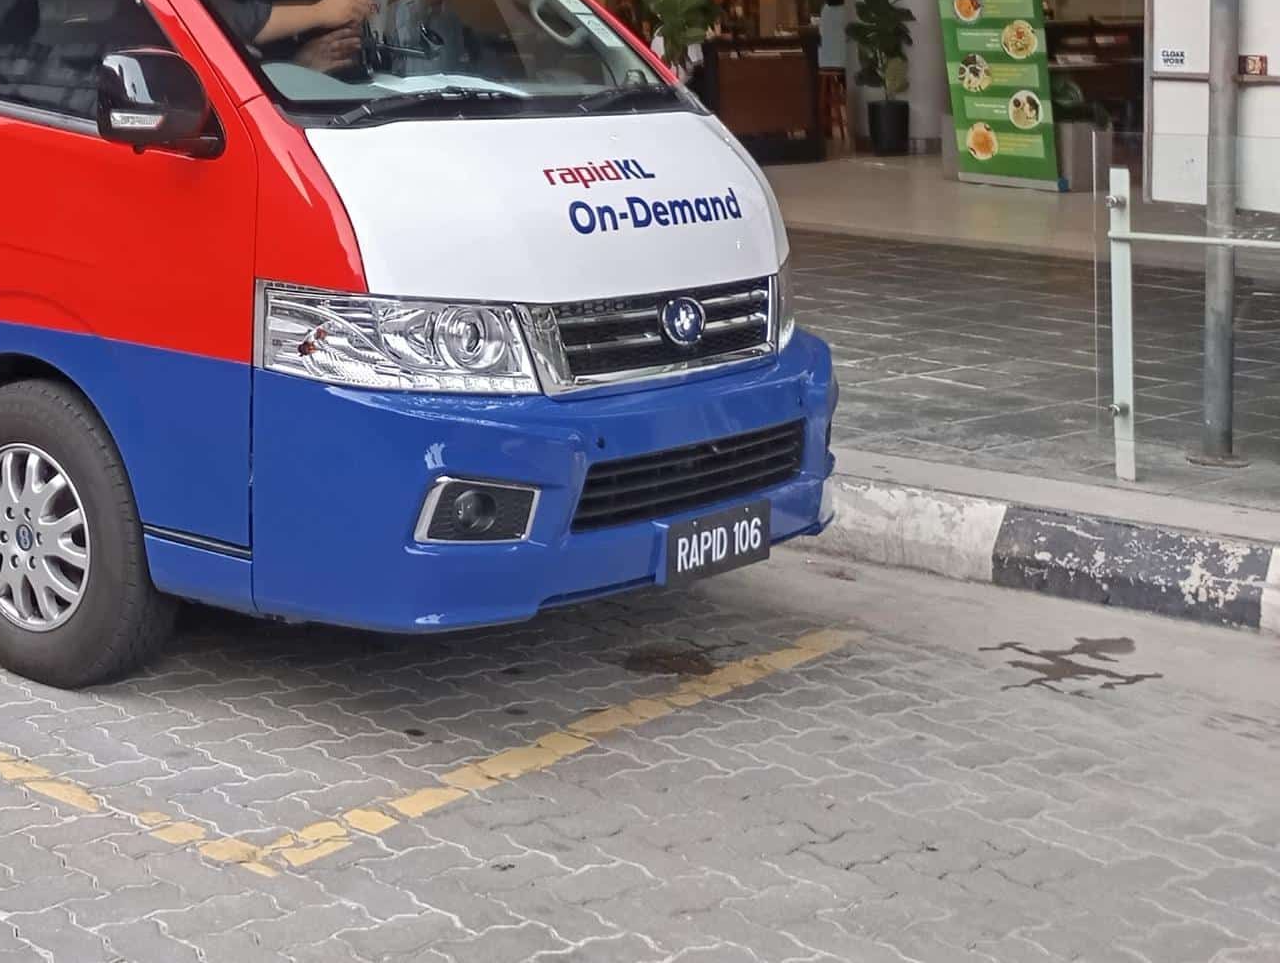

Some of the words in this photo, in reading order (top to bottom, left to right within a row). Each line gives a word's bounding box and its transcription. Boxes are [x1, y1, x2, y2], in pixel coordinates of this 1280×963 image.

[543, 158, 656, 189] rapidKL
[569, 187, 743, 235] On-Demand
[677, 526, 728, 573] RAPID
[733, 516, 762, 555] 106
